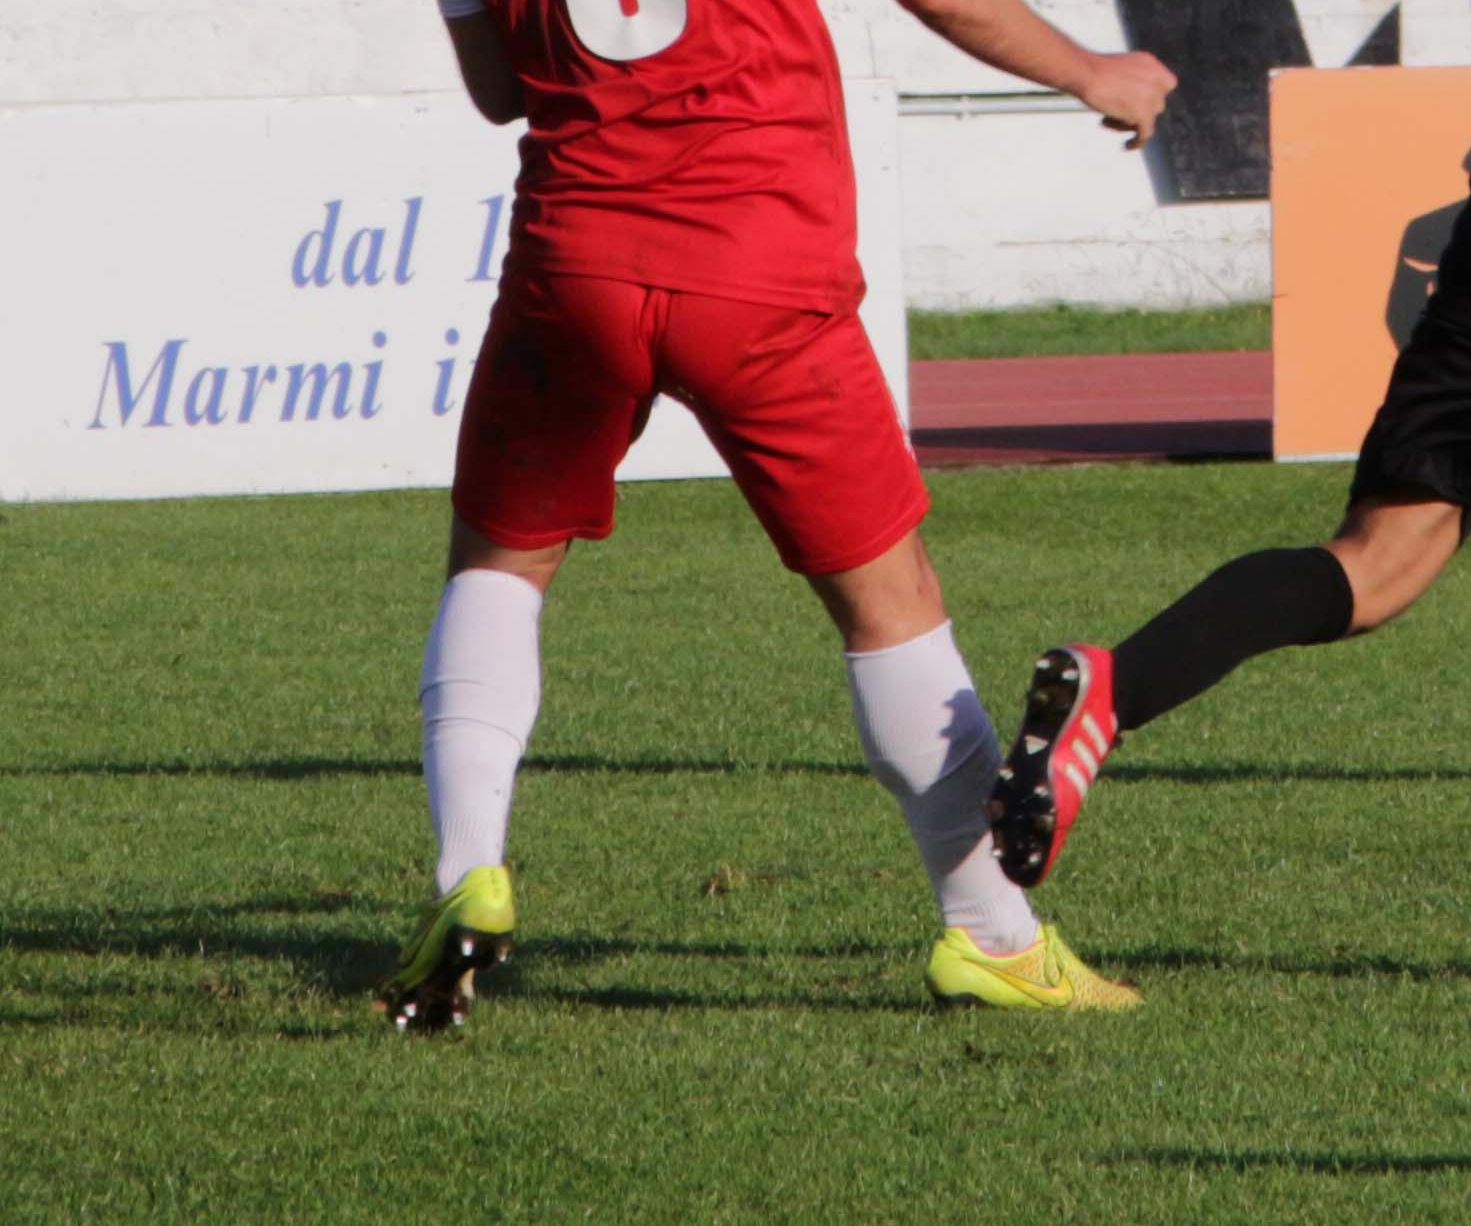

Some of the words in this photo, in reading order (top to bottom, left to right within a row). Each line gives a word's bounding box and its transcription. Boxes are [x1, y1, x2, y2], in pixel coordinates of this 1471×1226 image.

[291, 196, 424, 289] dal
[85, 330, 389, 431] Marmi
[431, 327, 478, 417] i
